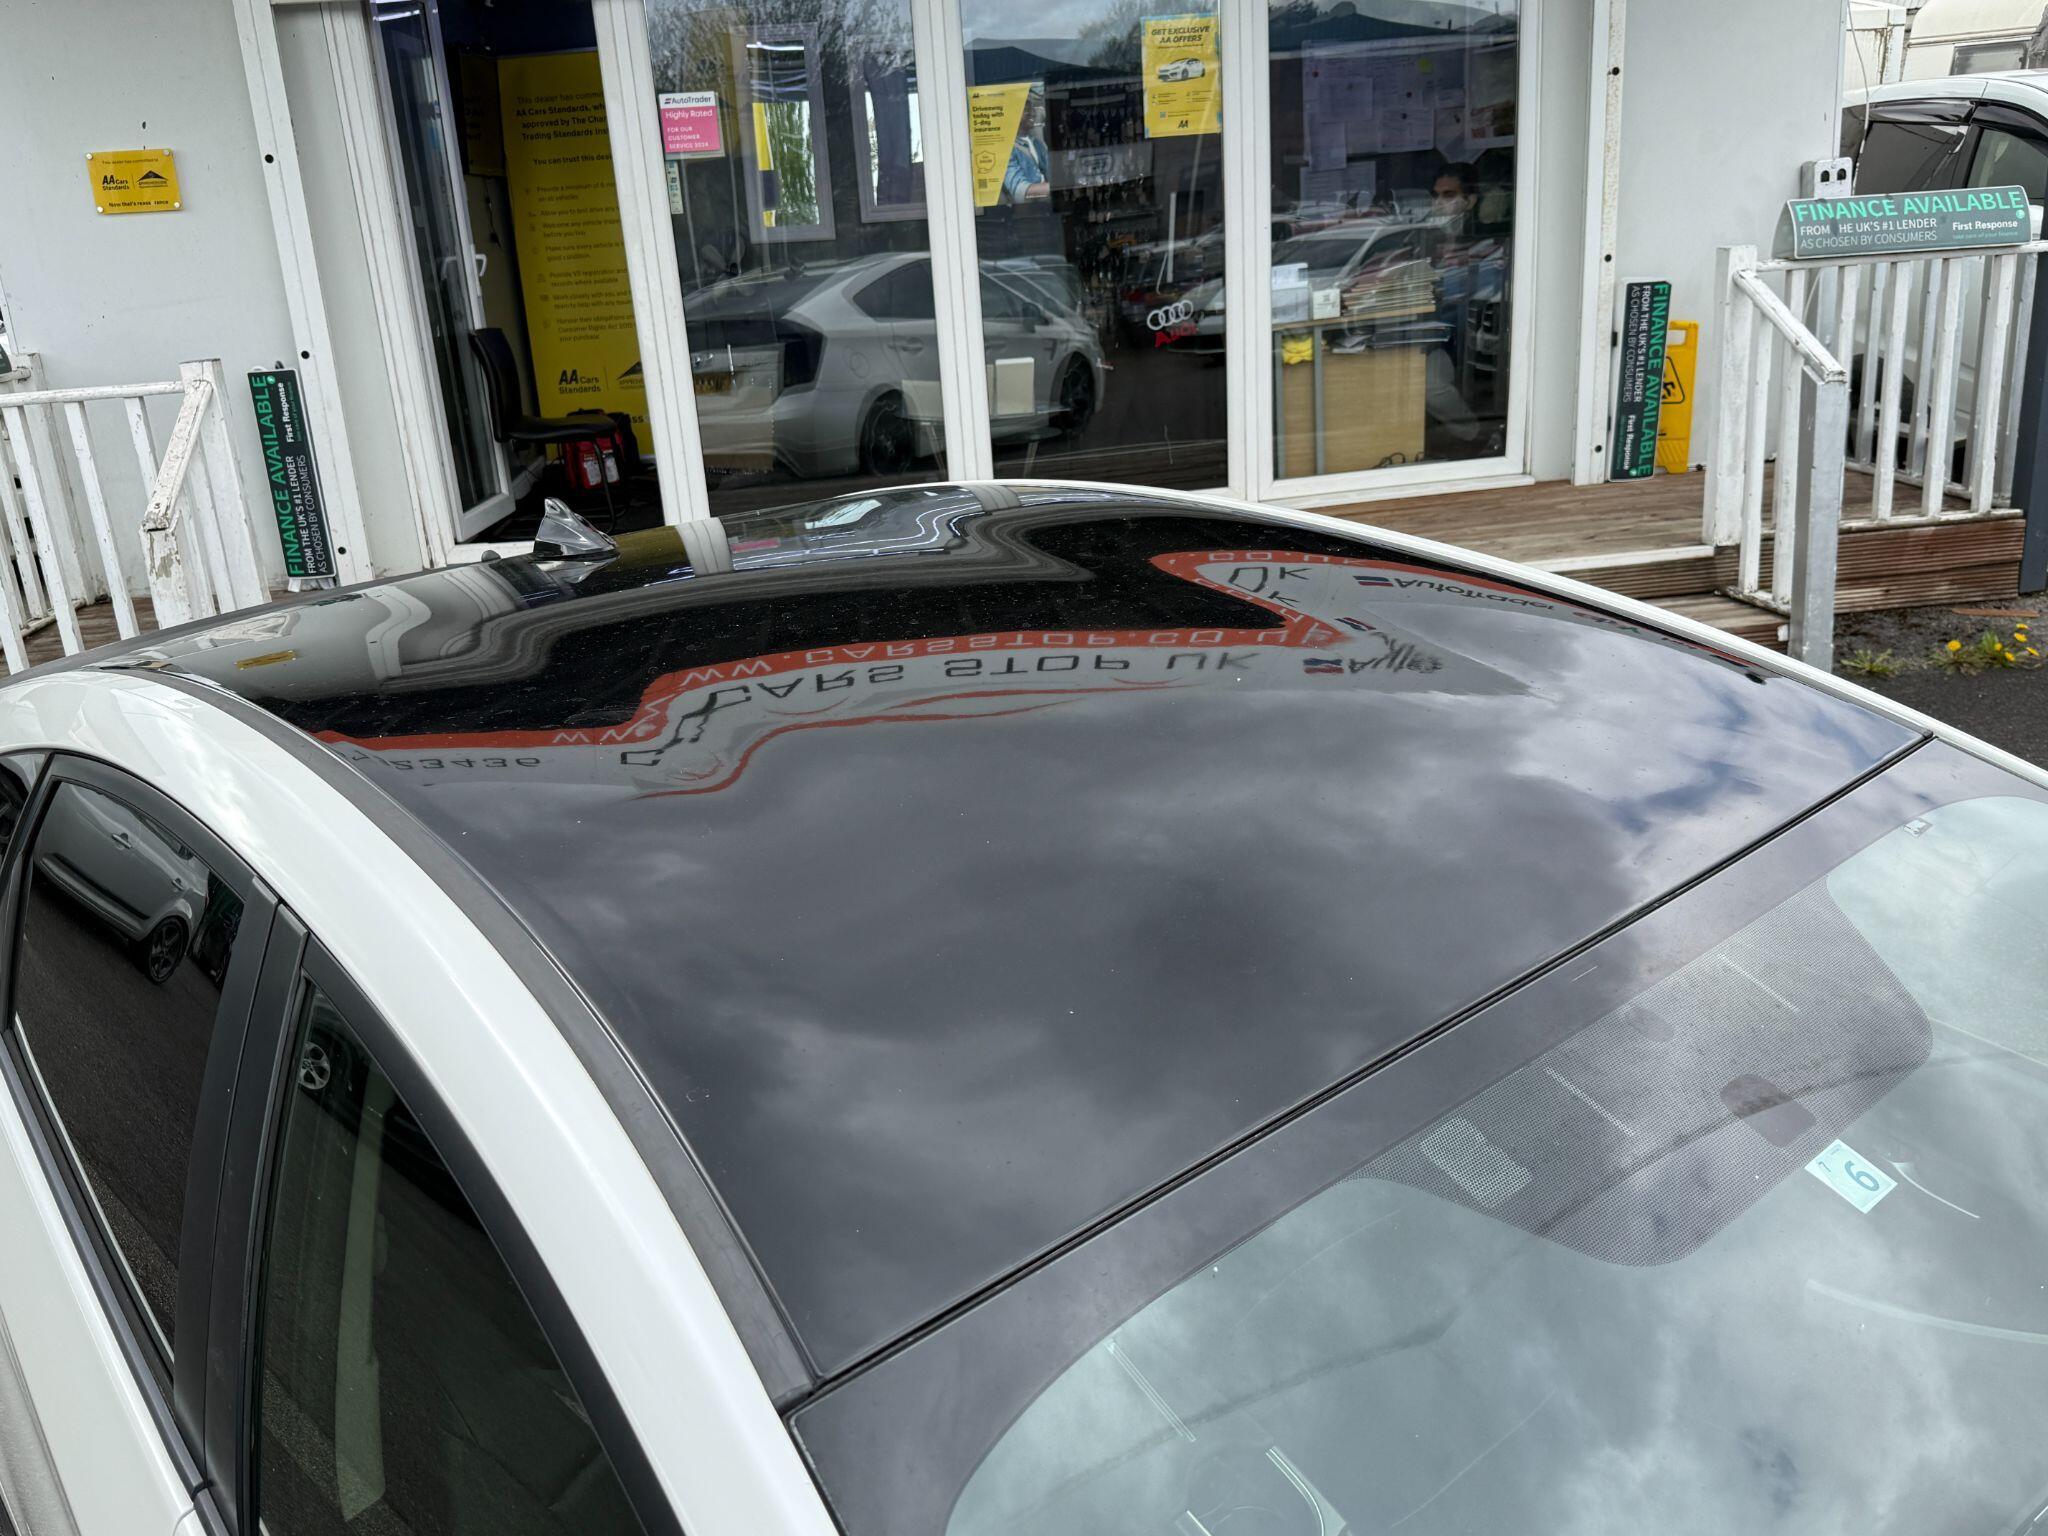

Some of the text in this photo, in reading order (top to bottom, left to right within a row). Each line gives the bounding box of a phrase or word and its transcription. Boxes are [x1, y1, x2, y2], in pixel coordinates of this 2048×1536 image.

[1152, 26, 1210, 36] GET EXCLUSIVE
[1173, 34, 1202, 43] OFFERS
[672, 96, 712, 105] AutoTrader
[528, 108, 546, 116] Cars
[571, 116, 586, 125] The
[666, 109, 712, 120] Highly Rated
[522, 132, 552, 142] Trading
[552, 129, 594, 138] Standards
[102, 174, 115, 185] AA
[1795, 191, 2024, 222] FINANCE AVAILABLE
[1800, 218, 1938, 236] FROM HE UK'S #1 LENDER
[1952, 220, 2018, 230] First Response
[1801, 230, 1938, 249] AS CHOSEN BY CONSUMERS
[1641, 285, 1651, 312] FROM
[1640, 313, 1649, 331] THE
[1622, 286, 1640, 402] AS CHOSEN BY CONSUMERS
[1638, 333, 1648, 354] UK'S
[559, 370, 599, 386] AA Cars
[1634, 368, 1644, 402] LENDER
[1638, 284, 1668, 476] FINANCE AVAILABLE
[559, 384, 602, 394] Standards
[278, 382, 291, 422] Response
[284, 424, 294, 443] First
[1623, 414, 1636, 470] First Response
[252, 375, 304, 574] FINANCE AVAILABLE
[297, 454, 315, 510] CONSUMERS
[286, 456, 316, 574] FROM THE UK'S #1 LENDER
[308, 512, 318, 522] BY
[310, 524, 325, 560] CHOSEN
[318, 562, 328, 573] AS
[1844, 1160, 1880, 1192] 6
